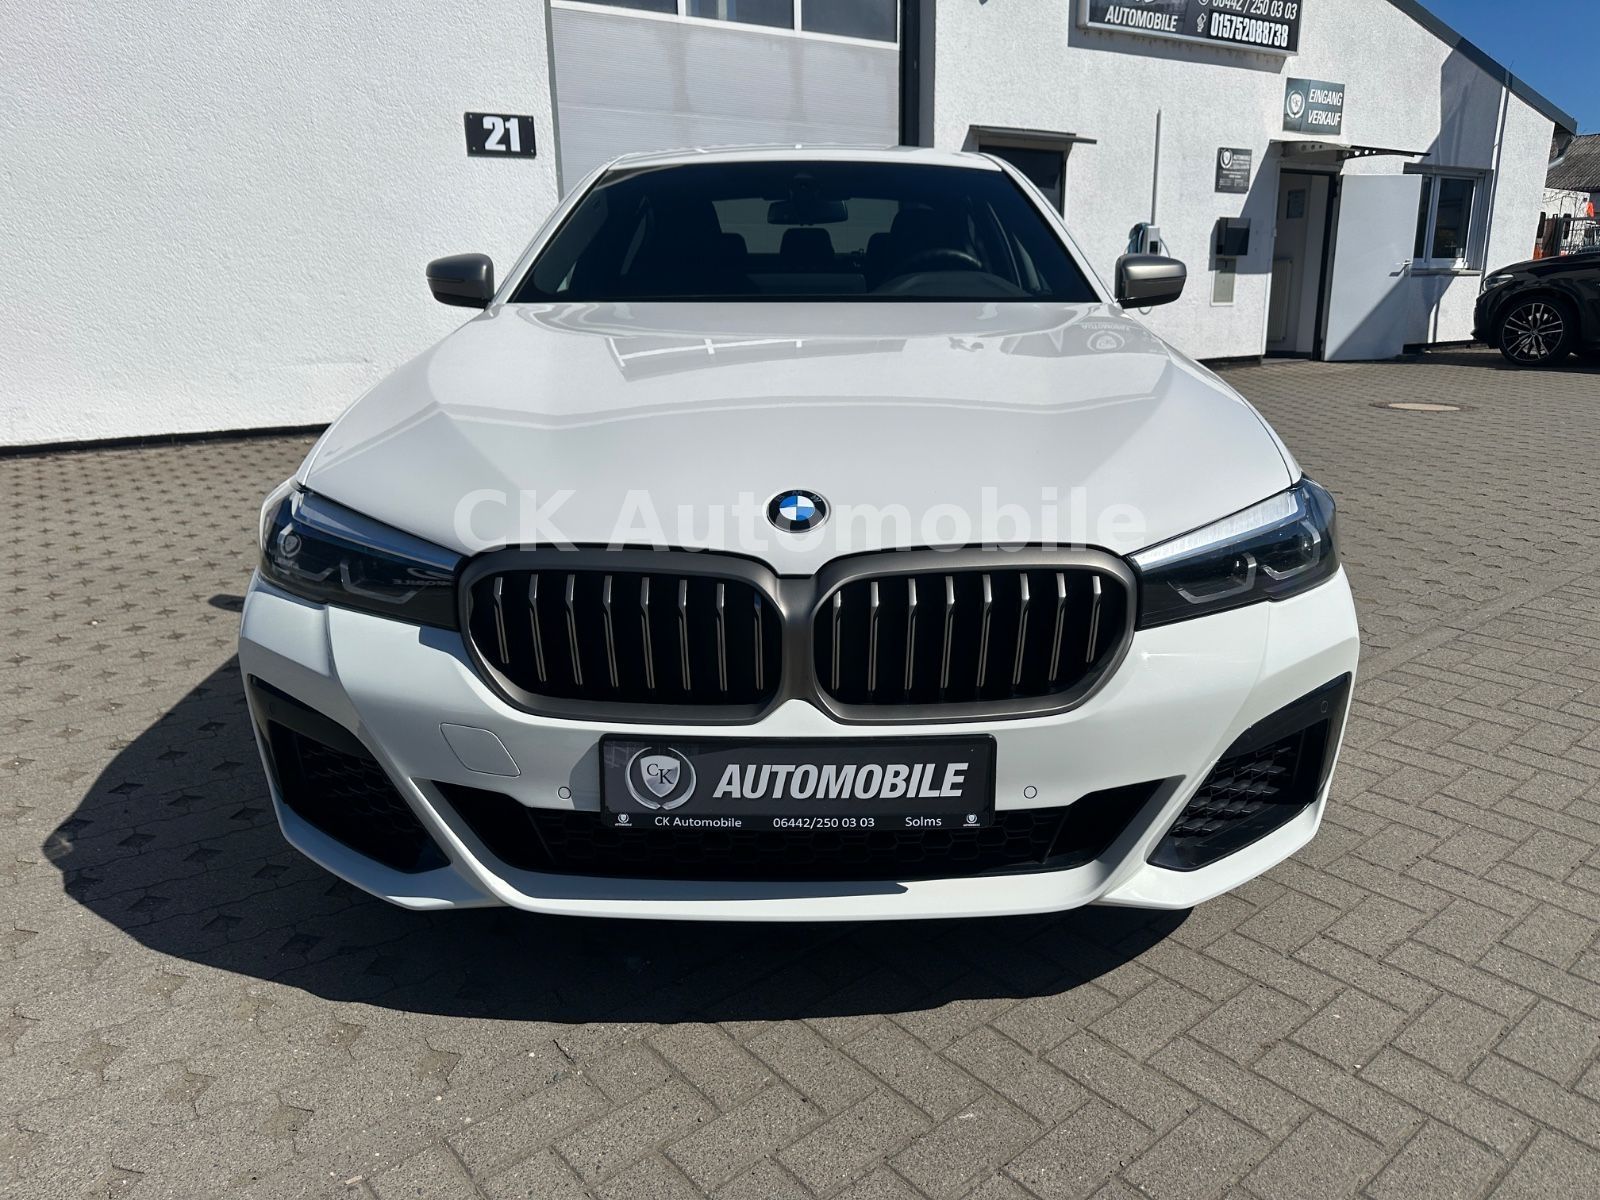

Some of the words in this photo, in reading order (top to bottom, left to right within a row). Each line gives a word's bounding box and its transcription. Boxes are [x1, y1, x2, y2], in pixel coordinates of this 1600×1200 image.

[1104, 5, 1178, 31] AUTOMOBILE
[1250, 0, 1269, 15] 250
[1270, 0, 1283, 17] 03
[1284, 2, 1297, 19] 03
[1210, 12, 1288, 47] 015752088738
[1308, 88, 1343, 106] EINGANG
[1307, 109, 1342, 127] VERKAUF
[482, 115, 521, 152] 21
[646, 763, 674, 785] CK
[712, 762, 969, 800] AUTOMOBILE
[654, 816, 670, 826] CK
[672, 816, 742, 828] Automobile
[772, 817, 839, 829] 06442/250
[841, 818, 857, 828] 03
[860, 817, 875, 828] 03
[905, 816, 942, 827] Solms
